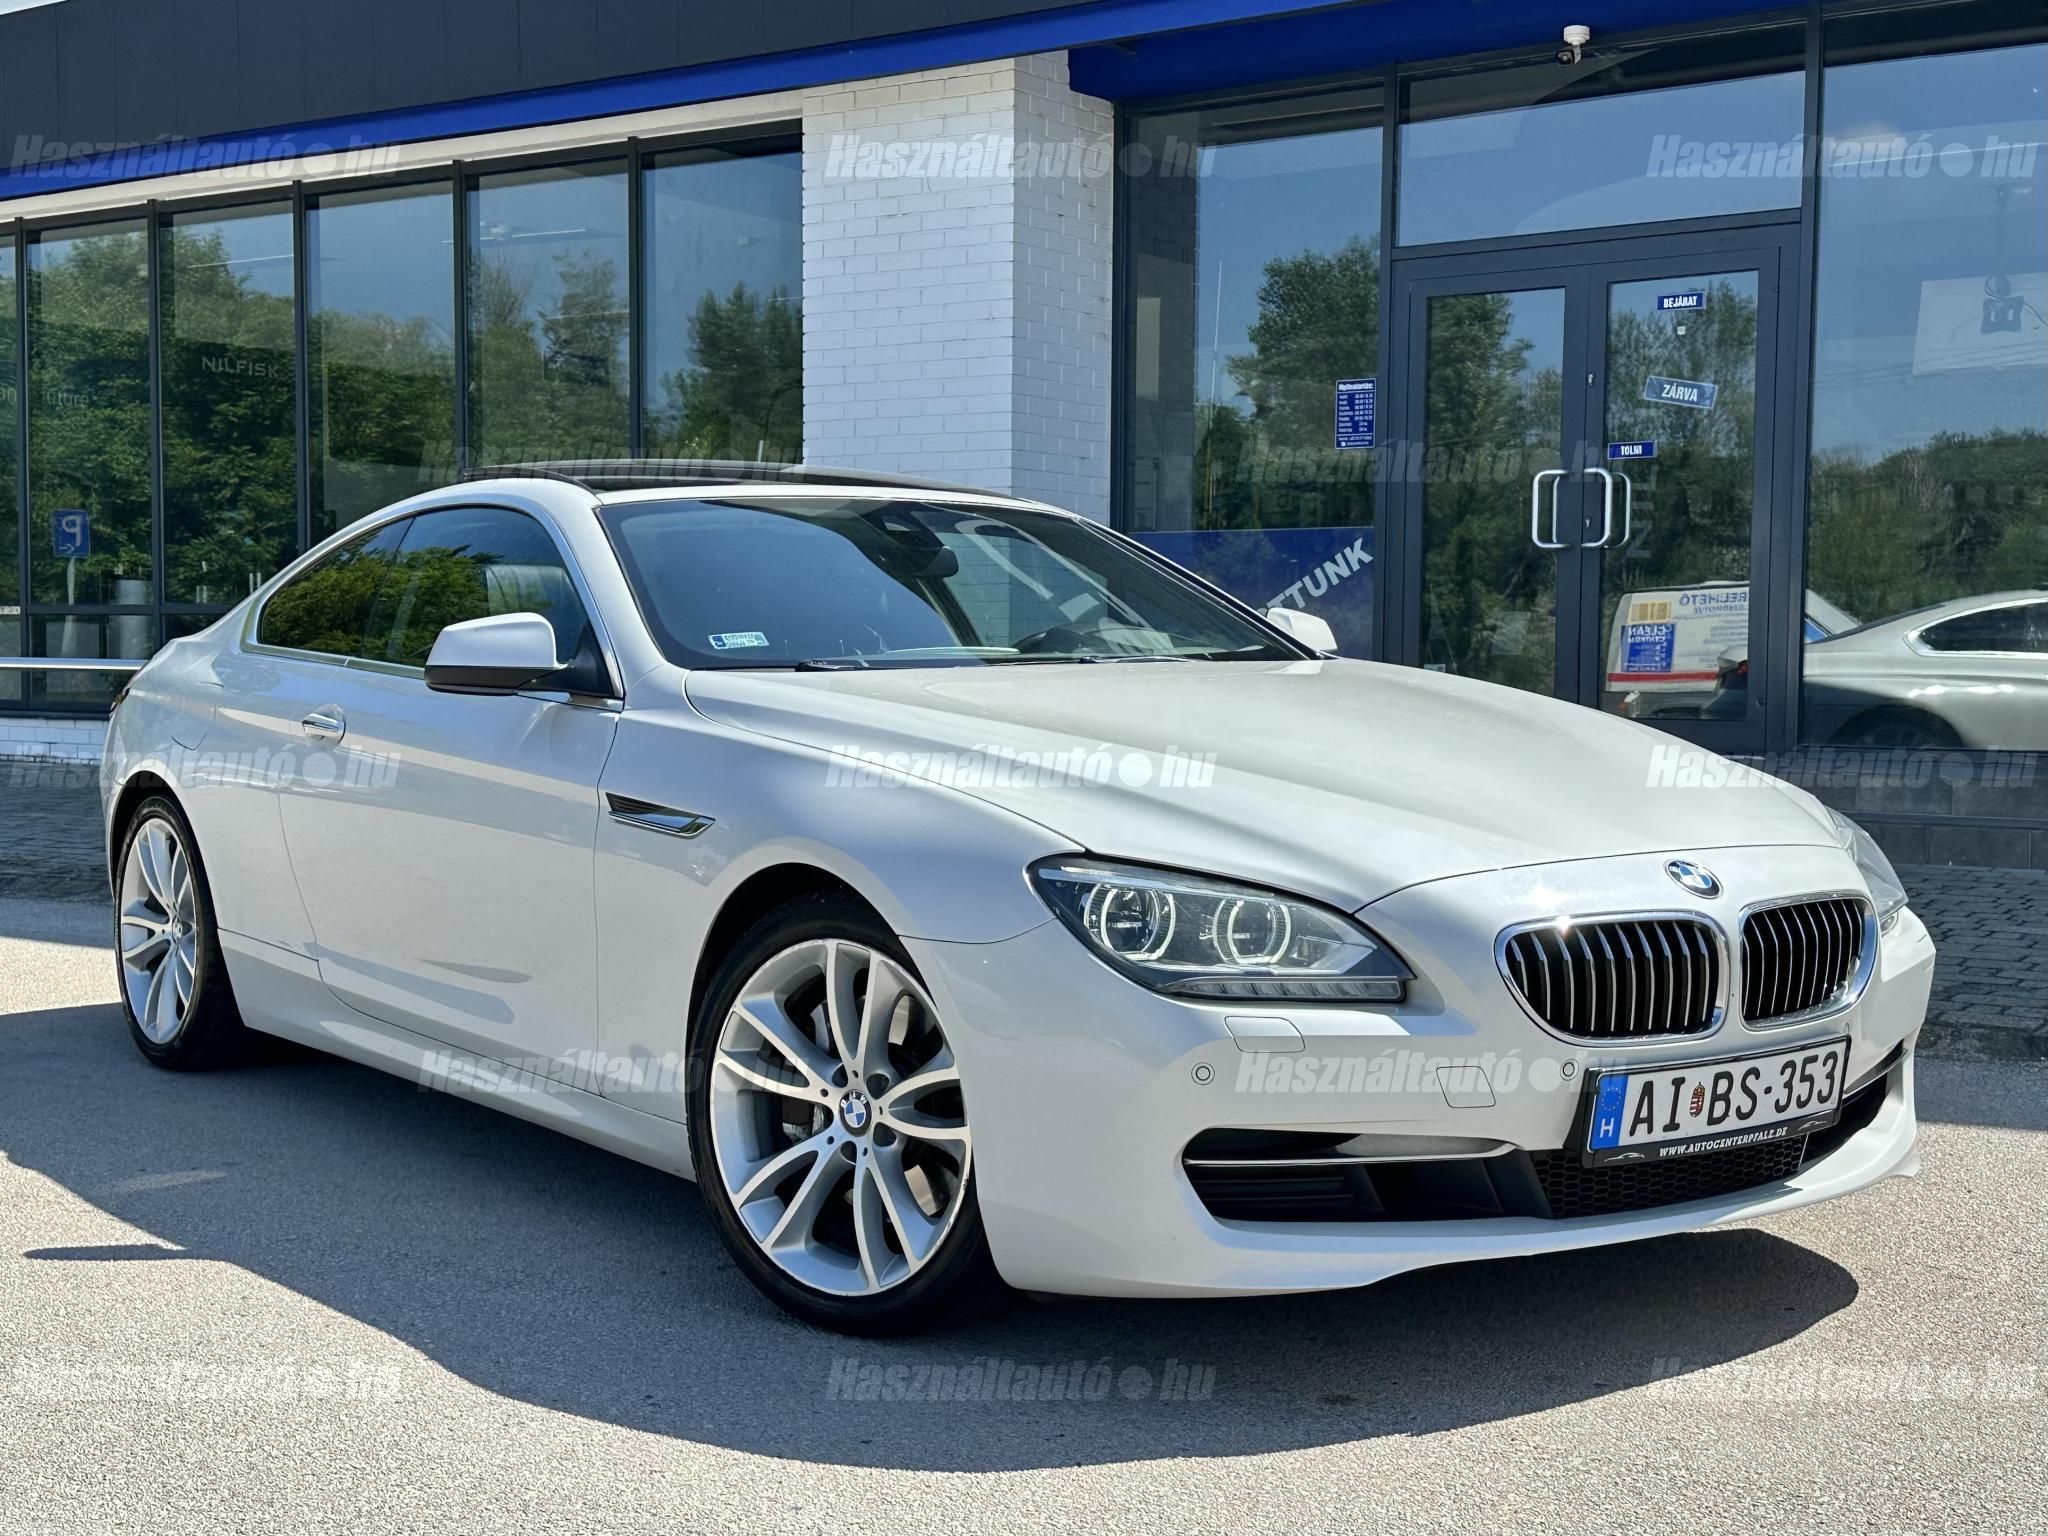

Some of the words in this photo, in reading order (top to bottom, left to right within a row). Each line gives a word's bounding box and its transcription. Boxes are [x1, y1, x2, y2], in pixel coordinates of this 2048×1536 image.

[1663, 295, 1698, 309] BEJÁRAT
[201, 356, 281, 378] NILFISK
[1661, 383, 1698, 402] ZÁRVA
[1257, 537, 1374, 617] TTUNK
[1707, 1051, 1839, 1126] BS-353
[1600, 1117, 1614, 1139] H
